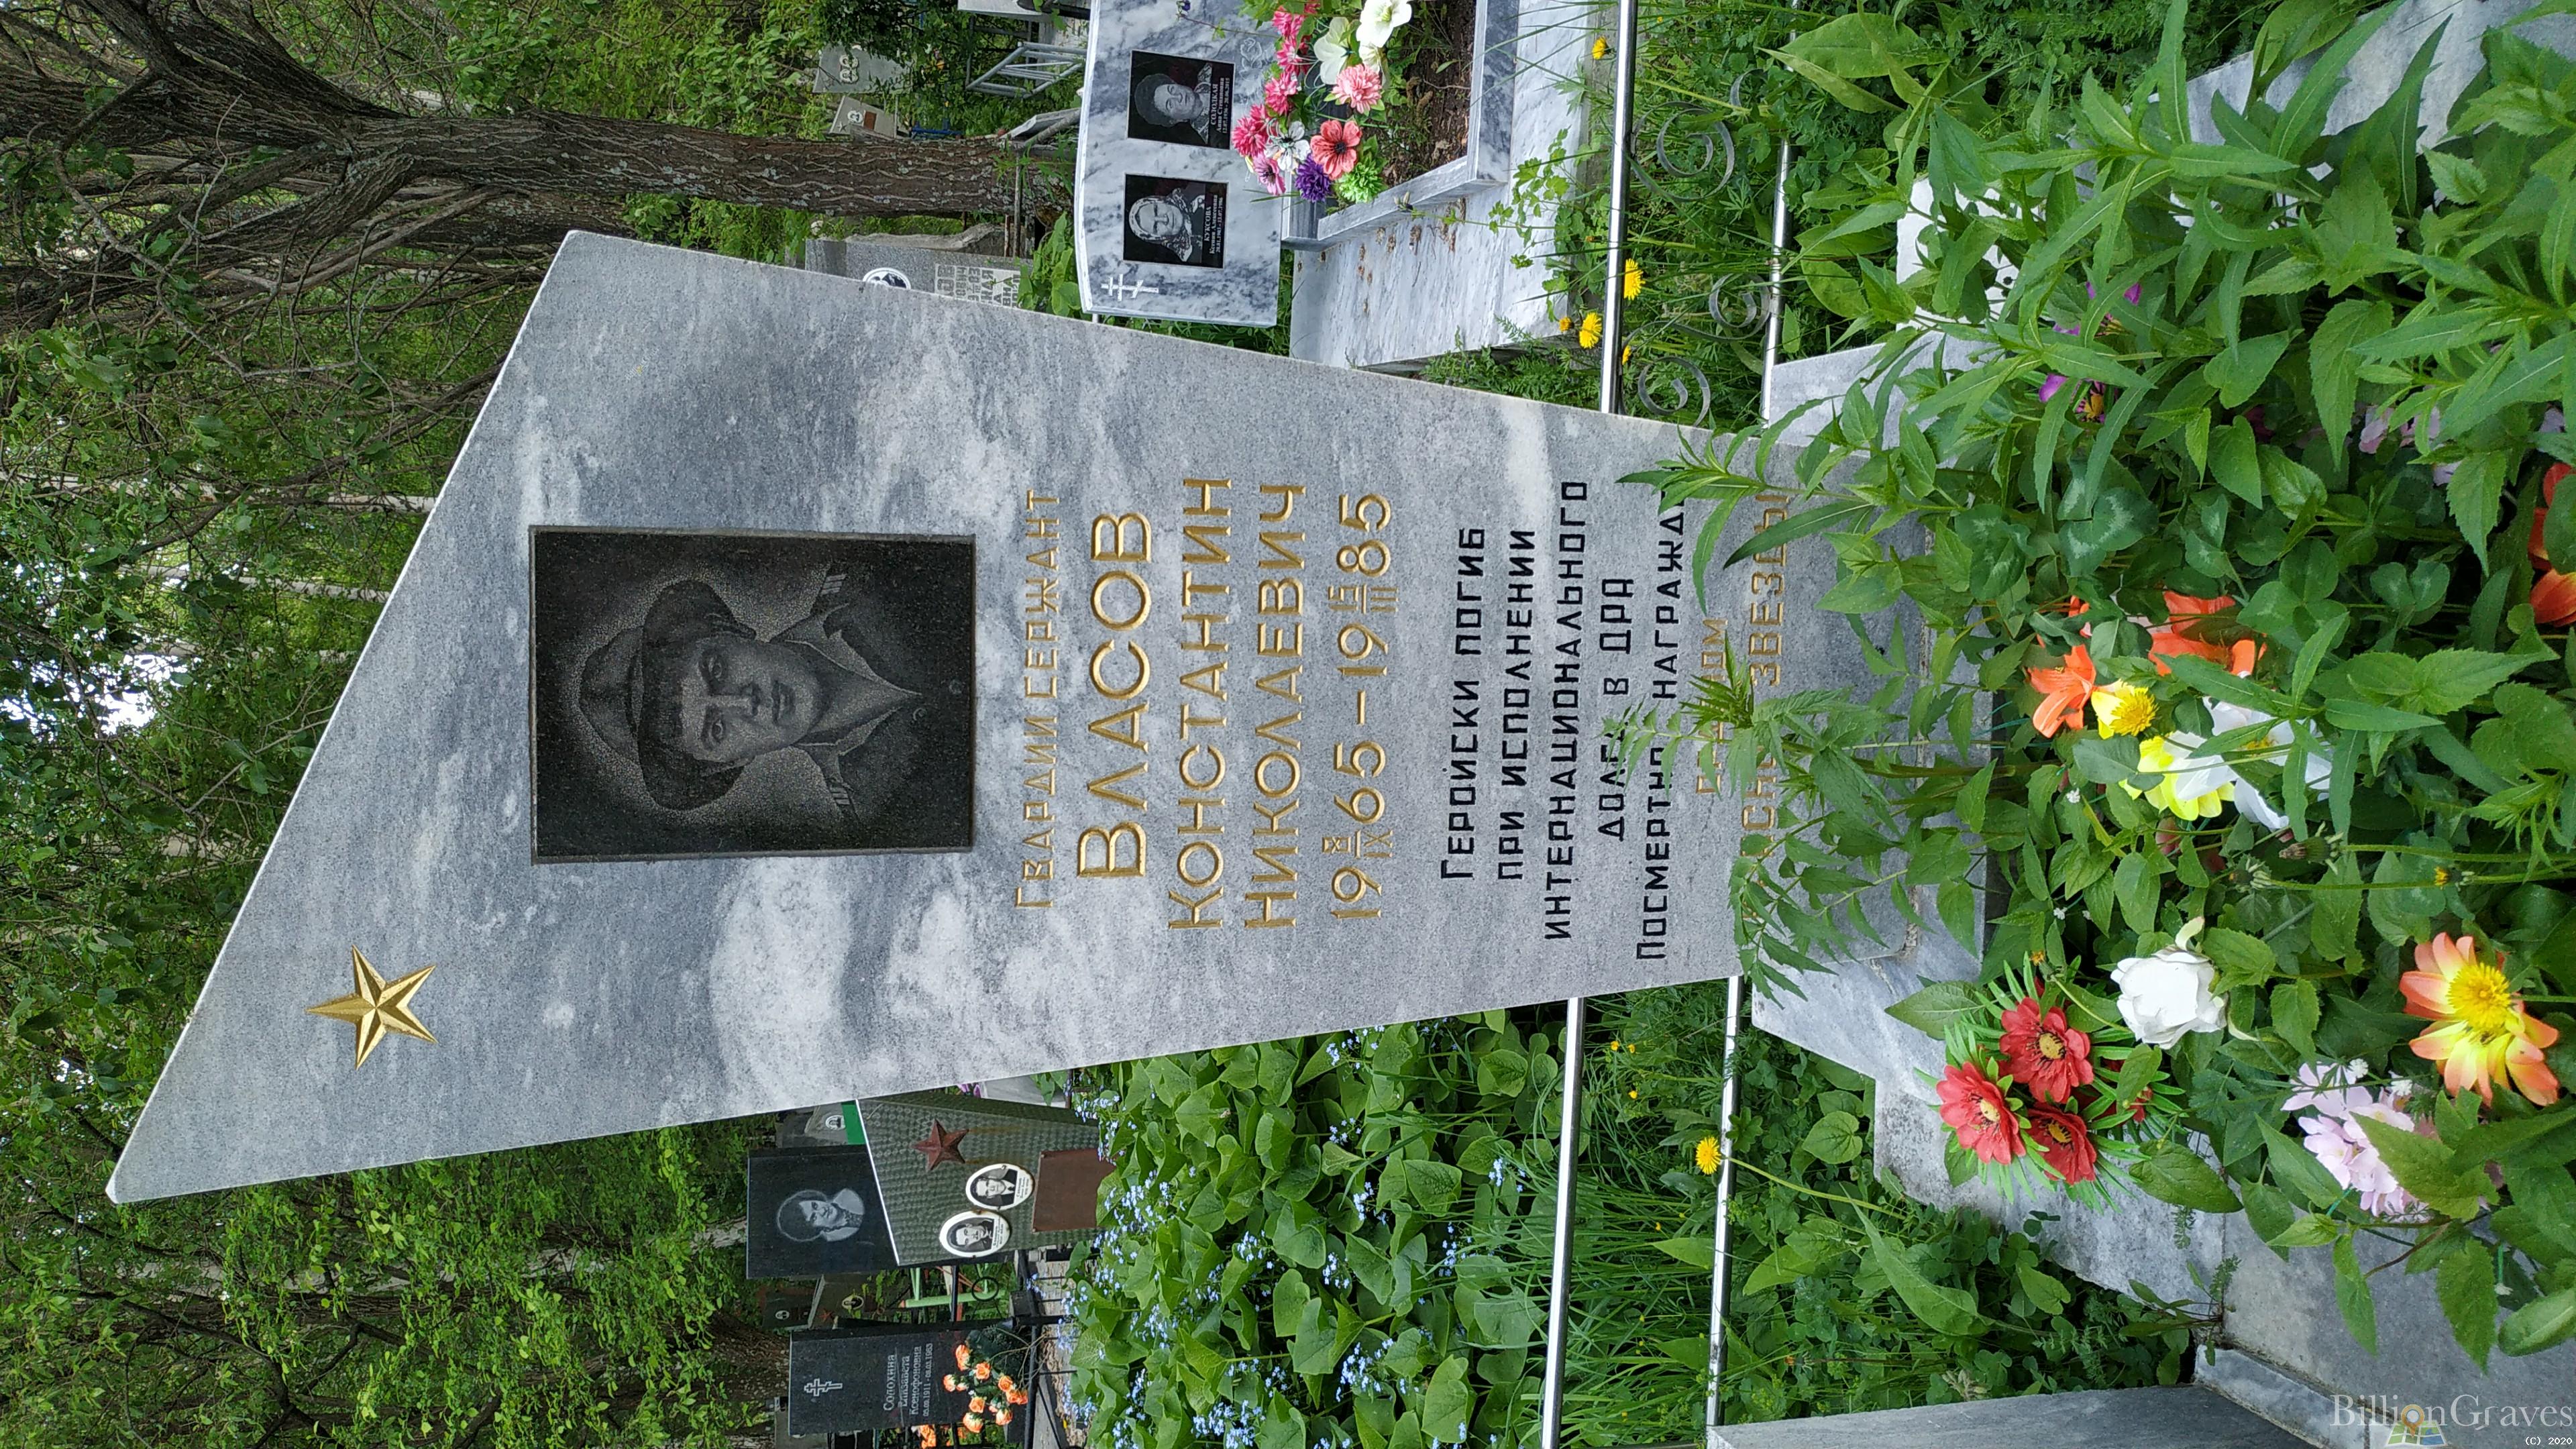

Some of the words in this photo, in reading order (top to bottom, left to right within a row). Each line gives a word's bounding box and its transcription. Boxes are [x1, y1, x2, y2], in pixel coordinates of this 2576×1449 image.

[937, 266, 954, 297] ОВ
[955, 267, 967, 303] ОВИЧ
[1024, 489, 1060, 700] СЕРЖАНТ
[1455, 528, 1485, 655] ПОГИБ
[1501, 531, 1535, 786] ИСПОЛНЕНИИ
[1599, 578, 1634, 654] ДРА
[1652, 466, 1684, 699] НАГРАЖД
[1076, 513, 1152, 878] ВЛАСОВ
[1168, 478, 1231, 930] КОНСТАНТИН
[1244, 484, 1305, 929] НИКОЛАЕВИЧ
[1544, 482, 1587, 940] ИНТЕРНАЦИОНАЛЬНОГО
[1603, 678, 1629, 695] В
[1014, 716, 1057, 908] ГВАРДИИ
[1498, 812, 1525, 879] ПРИ
